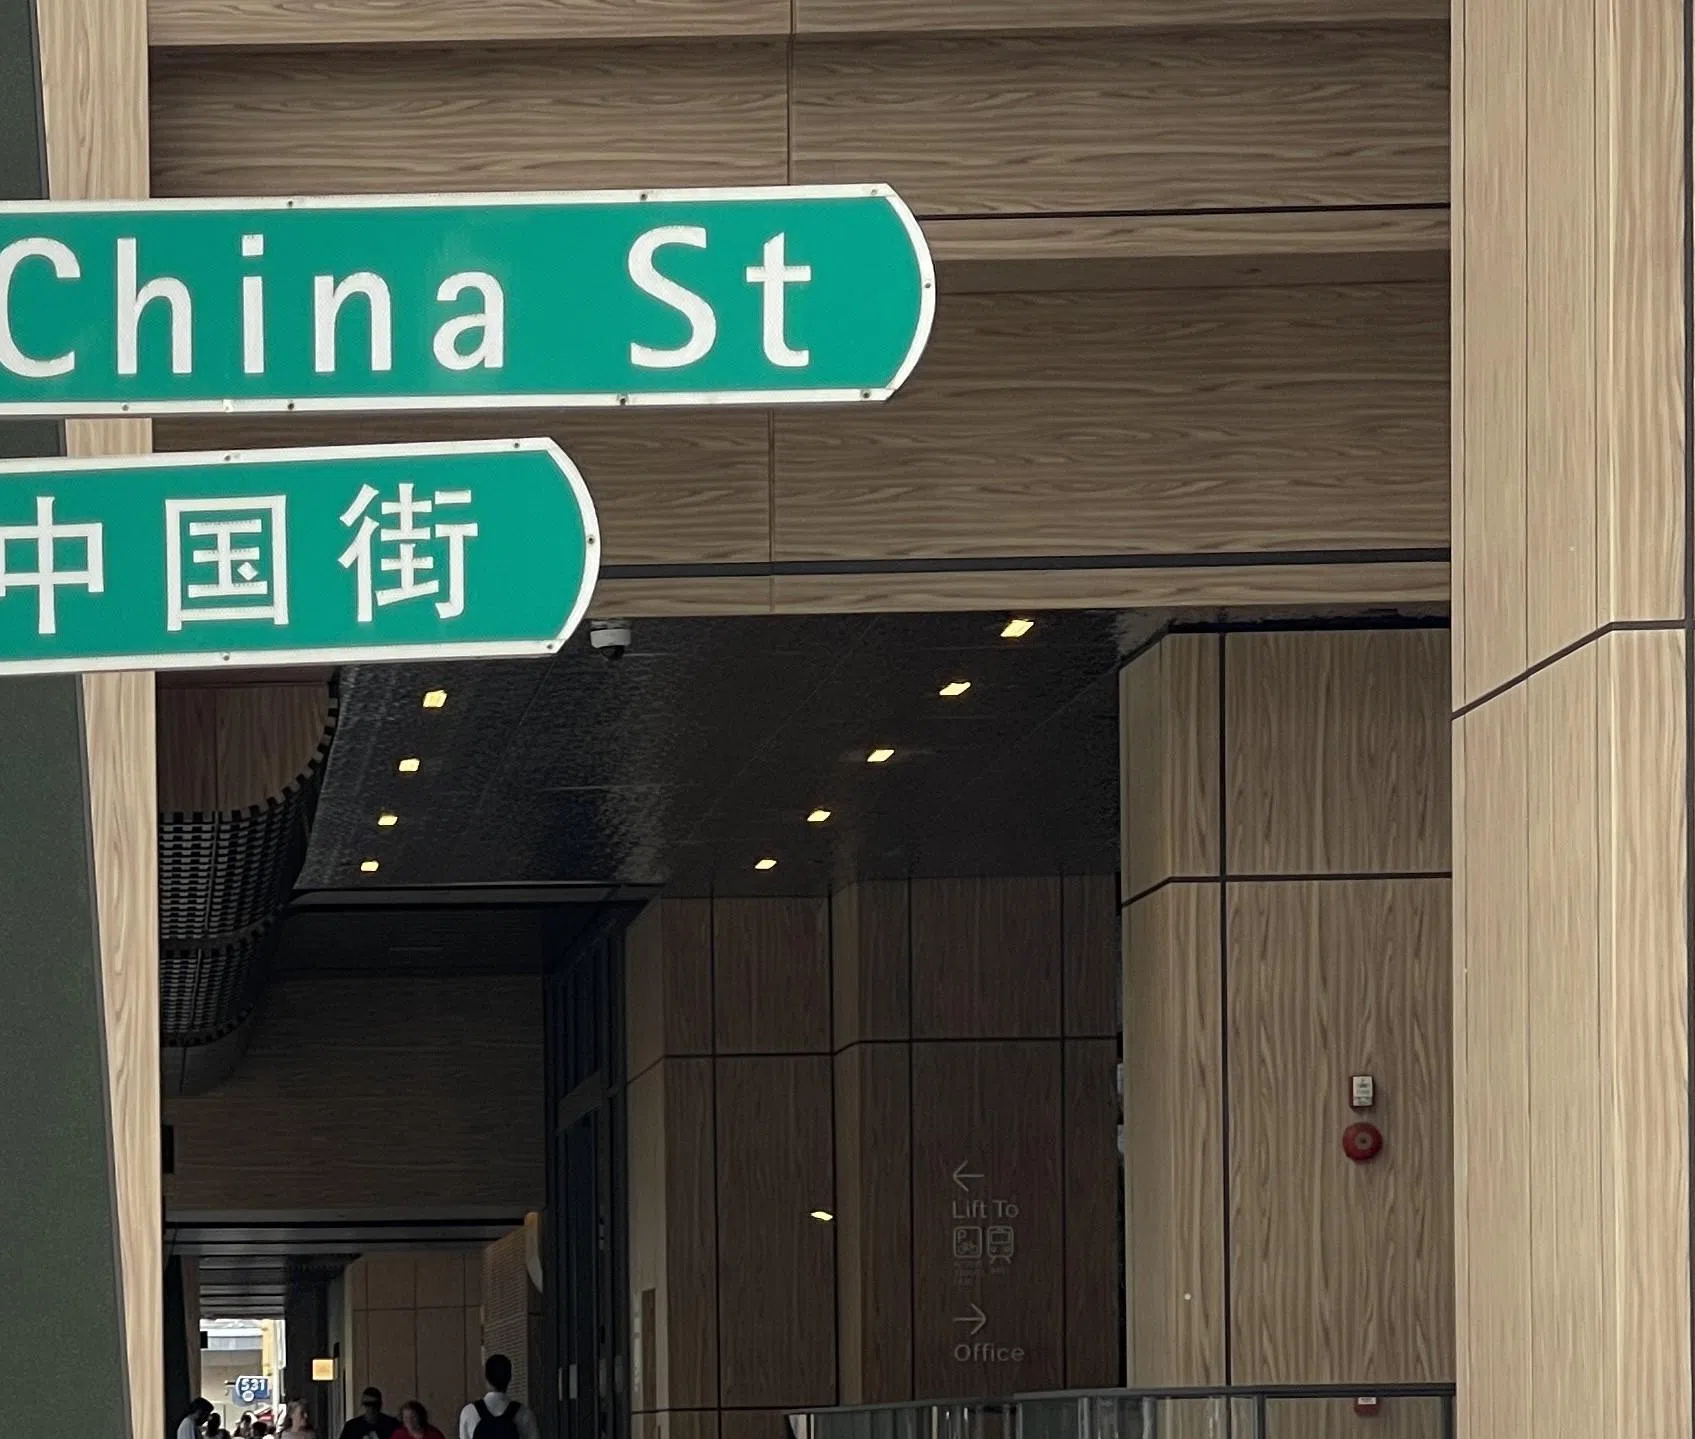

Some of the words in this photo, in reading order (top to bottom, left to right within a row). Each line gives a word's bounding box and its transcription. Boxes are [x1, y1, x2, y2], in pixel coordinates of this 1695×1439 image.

[628, 226, 811, 368] St
[952, 1200, 987, 1219] Lift
[992, 1200, 1019, 1219] To
[954, 1343, 1025, 1362] Office
[241, 1379, 265, 1391] 531
